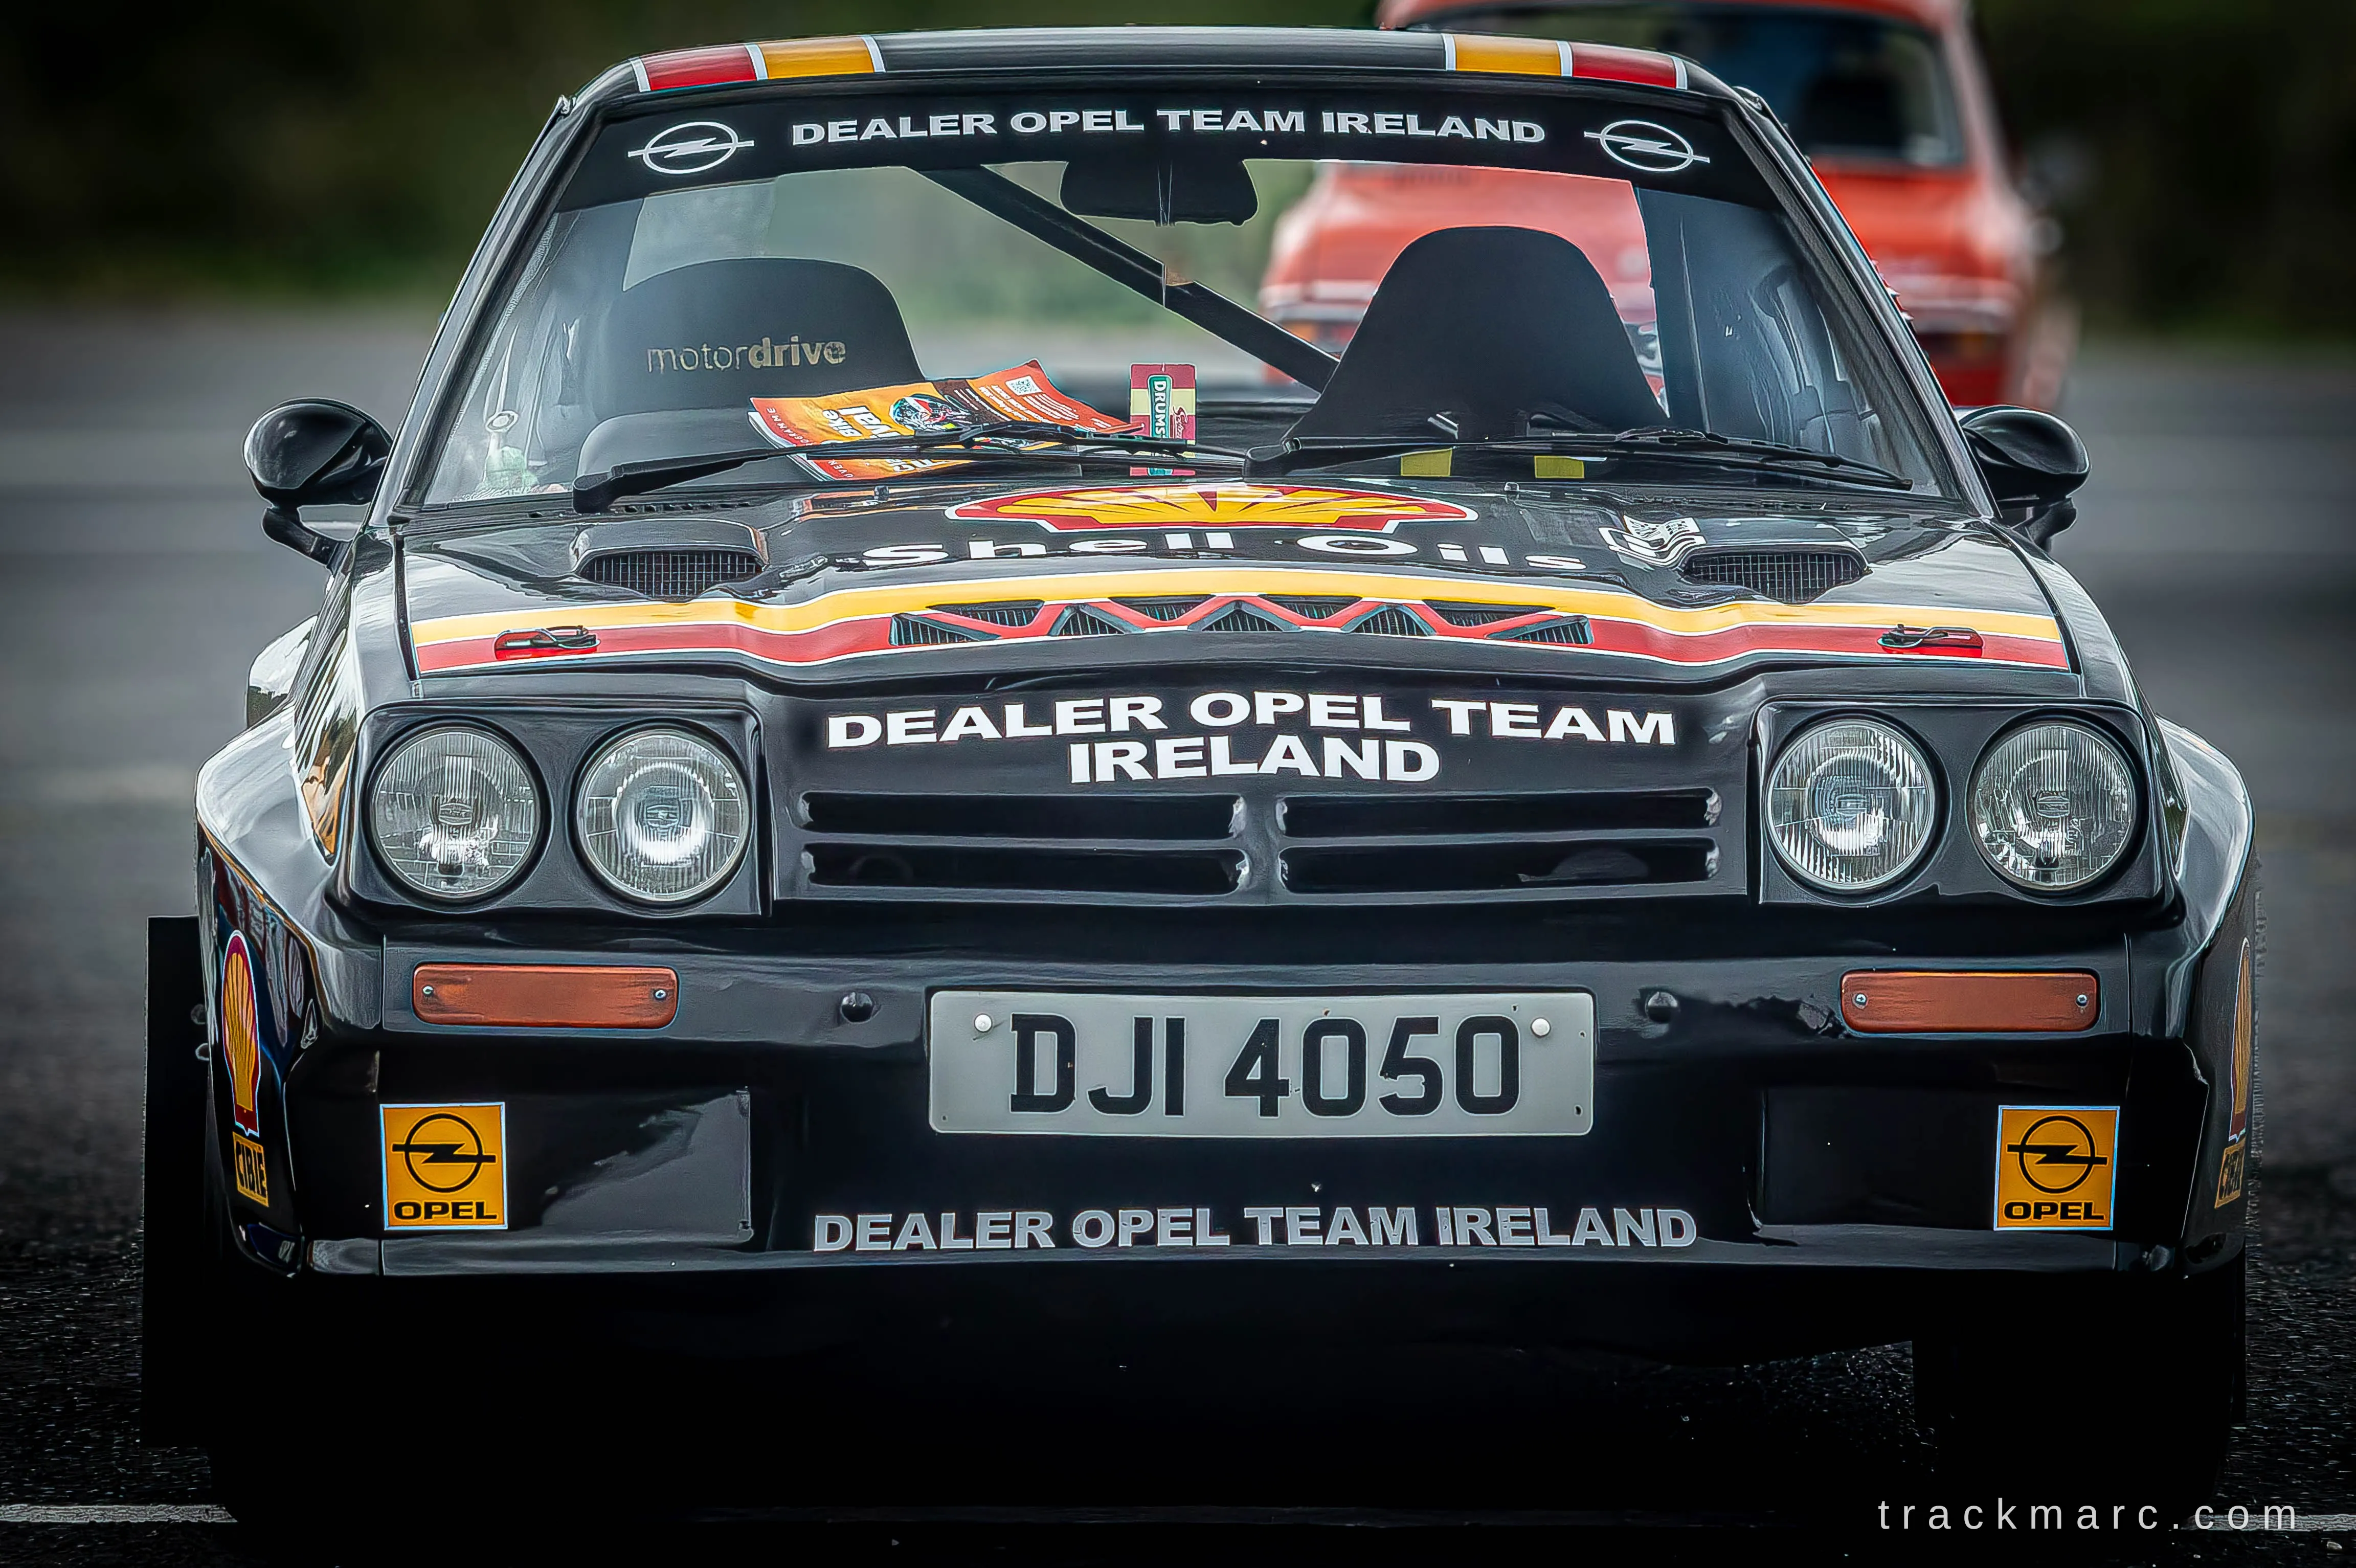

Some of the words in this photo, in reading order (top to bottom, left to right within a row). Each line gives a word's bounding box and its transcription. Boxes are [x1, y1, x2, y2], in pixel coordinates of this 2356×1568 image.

[792, 113, 997, 146] DEALER
[1010, 109, 1144, 132] OPEL
[1156, 109, 1305, 132] TEAM
[1322, 110, 1545, 143] IRELAND
[647, 335, 846, 374] motordrive
[822, 409, 863, 437] Bike
[1153, 380, 1167, 438] DRUMS
[863, 532, 1235, 567] Shell
[1297, 535, 1586, 570] Oils
[827, 696, 1168, 748] DEALER
[1190, 691, 1411, 731] OPEL
[1431, 699, 1676, 744] TEAM
[1070, 734, 1440, 784] IRELAND
[1010, 1013, 1185, 1117] DJI
[1224, 1015, 1520, 1117] 4050
[393, 1201, 498, 1220] OPEL
[814, 1210, 1056, 1251] DEALER
[1072, 1207, 1230, 1247] OPEL
[1244, 1206, 1419, 1246] TEAM
[1436, 1207, 1697, 1247] IRELAND
[2004, 1201, 2104, 1220] OPEL
